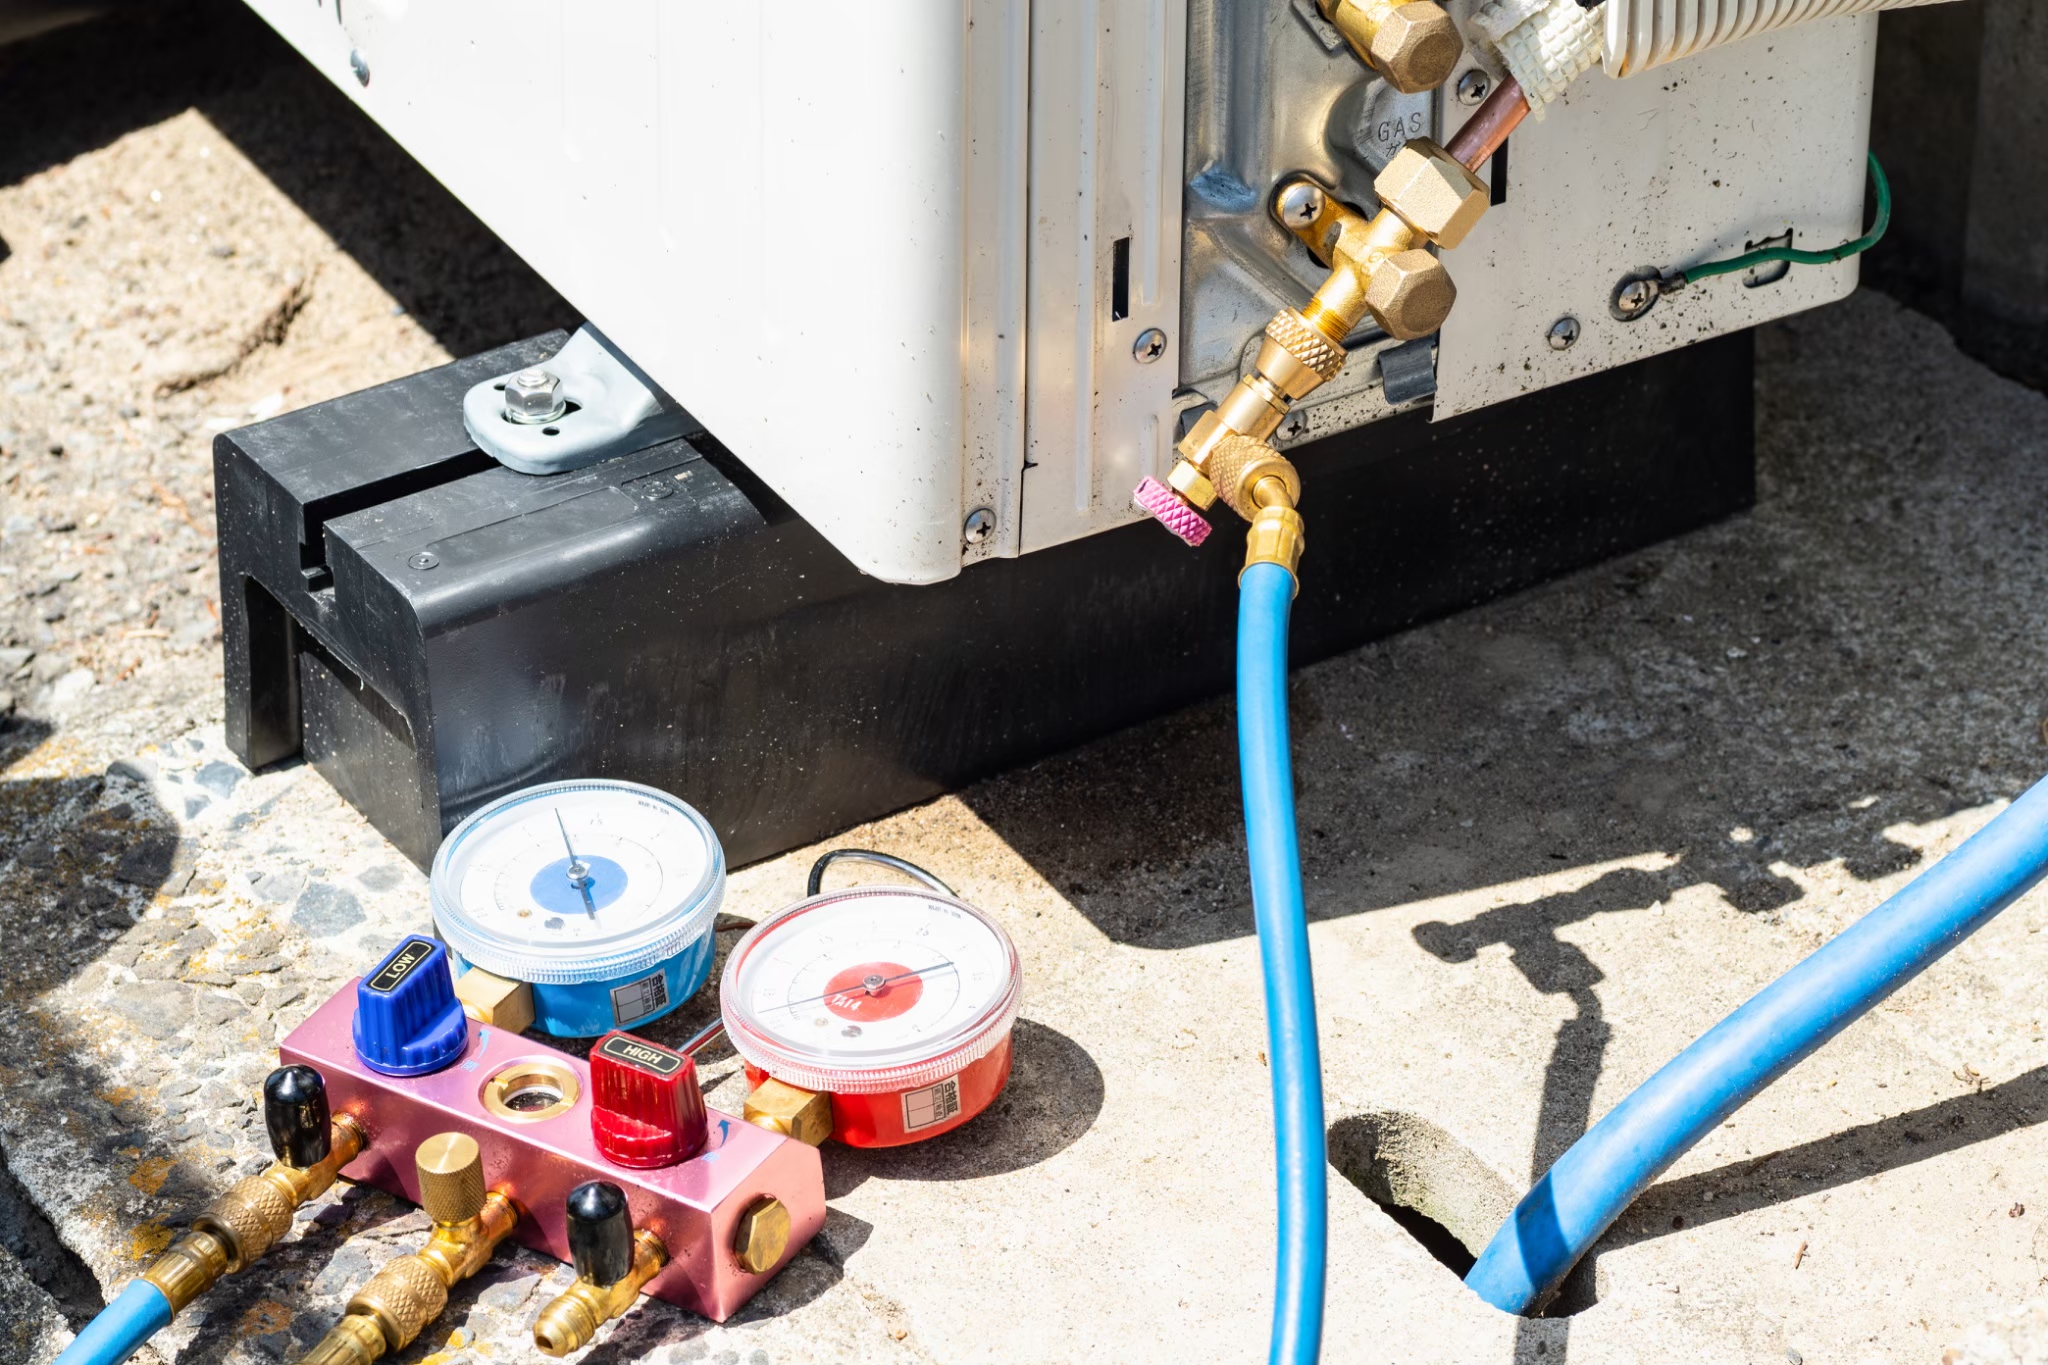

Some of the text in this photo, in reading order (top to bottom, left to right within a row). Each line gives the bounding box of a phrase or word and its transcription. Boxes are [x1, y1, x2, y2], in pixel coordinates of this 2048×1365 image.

[1378, 112, 1421, 142] GAS
[385, 953, 415, 979] LOW
[622, 1045, 663, 1064] HIGH
[944, 1080, 959, 1116] 合格証
